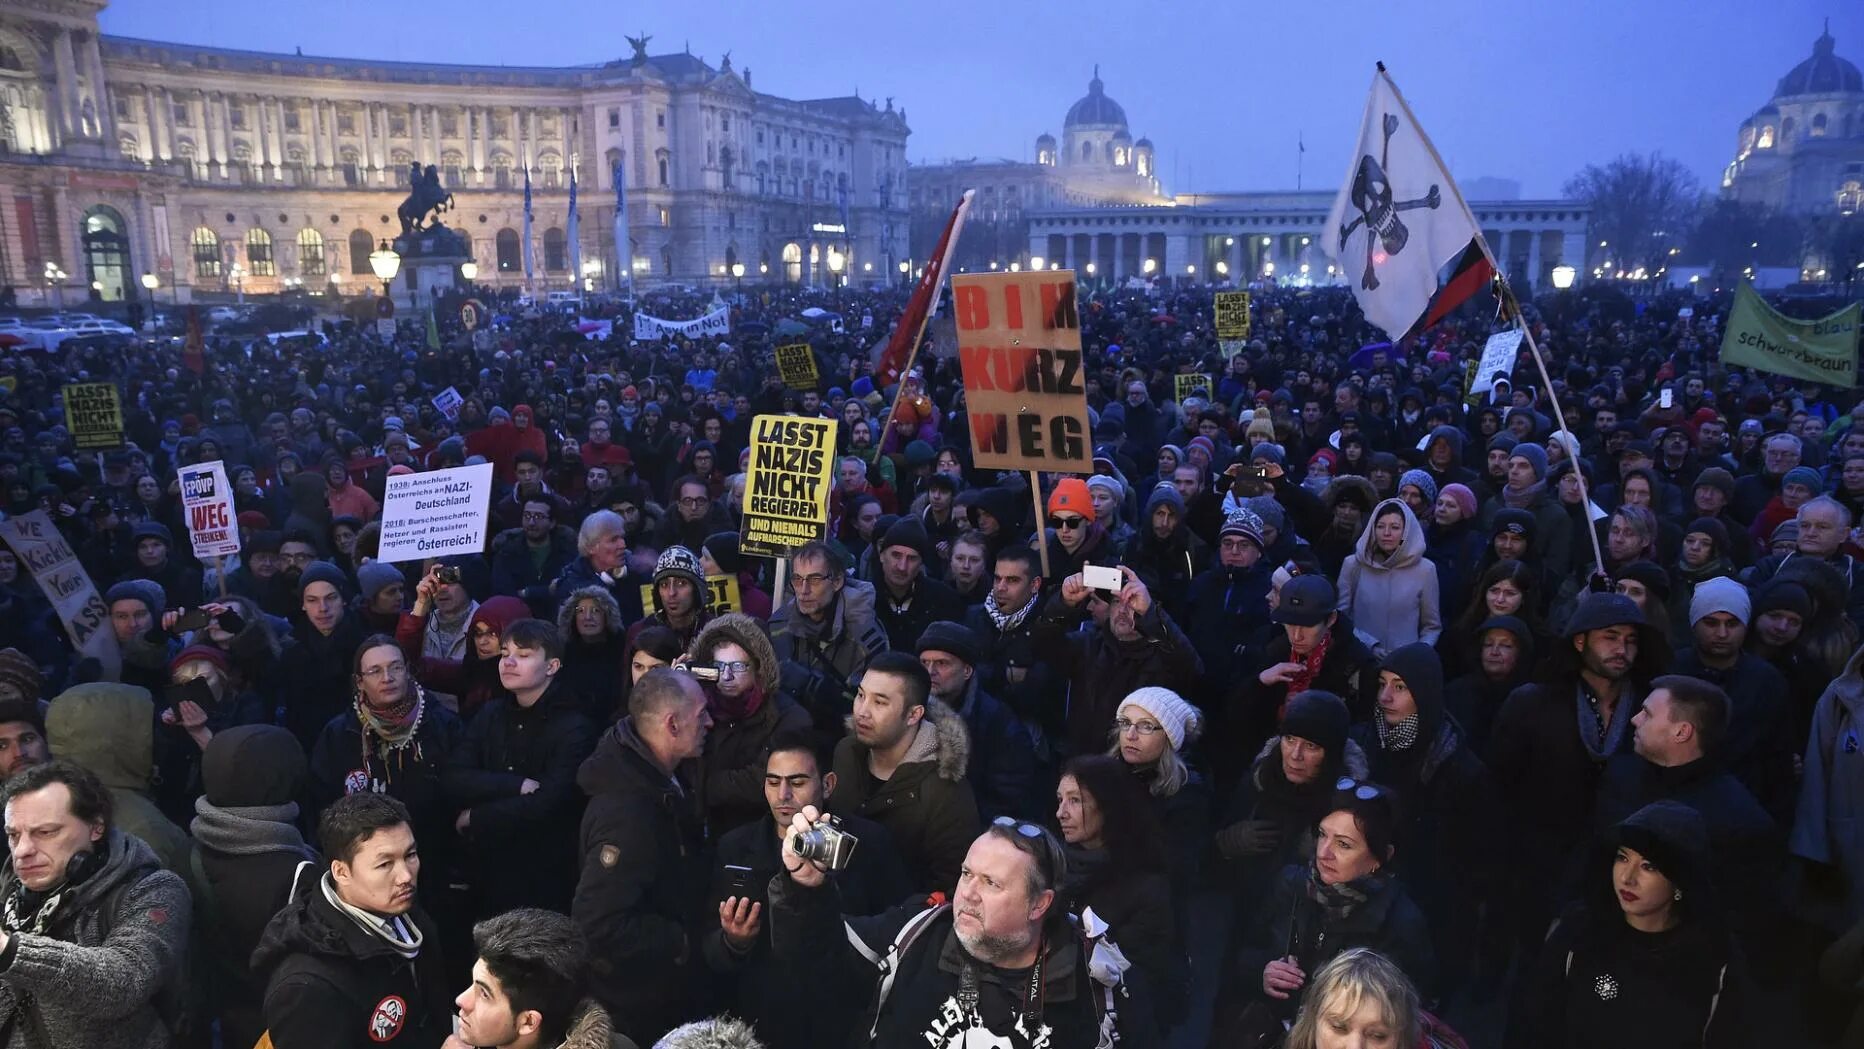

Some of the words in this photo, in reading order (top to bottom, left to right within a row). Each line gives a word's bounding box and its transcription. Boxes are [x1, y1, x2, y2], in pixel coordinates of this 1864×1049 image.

[1218, 294, 1246, 303] LASST
[1218, 303, 1247, 311] NAZIS
[464, 309, 473, 323] 30
[1218, 311, 1247, 320] NICHT
[686, 324, 699, 333] in
[702, 315, 726, 330] Not
[1813, 320, 1853, 336] blau
[778, 345, 807, 357] LASST
[780, 355, 811, 367] NAZIS
[782, 364, 812, 375] NICHT
[959, 345, 1084, 394] KURZ
[68, 384, 112, 399] LASST
[69, 398, 115, 411] NAZIS
[71, 410, 116, 425] NICHT
[757, 420, 828, 449] LASST
[972, 412, 1084, 461] WEG
[755, 445, 824, 475] NAZIS
[184, 475, 213, 496] FPÖVP
[389, 481, 410, 490] 1938:
[411, 476, 452, 487] Anschluss
[753, 471, 821, 501] NICHT
[388, 487, 433, 500] Österreichs
[415, 494, 471, 510] Deutschland
[751, 496, 818, 519] REGIEREN
[191, 502, 229, 531] WEG
[15, 520, 43, 537] WE
[384, 520, 406, 529] 2018:
[384, 530, 409, 539] Hetzer
[412, 528, 426, 536] und
[429, 523, 468, 534] Rassisten
[750, 518, 770, 531] UND
[771, 520, 817, 538] NIEMALS
[193, 530, 228, 545] STREIKEN!
[383, 538, 416, 548] regieren
[747, 531, 808, 546] AUFMARSCHIER
[72, 597, 107, 643] ASS
[1030, 964, 1040, 1002] DIGITAL
